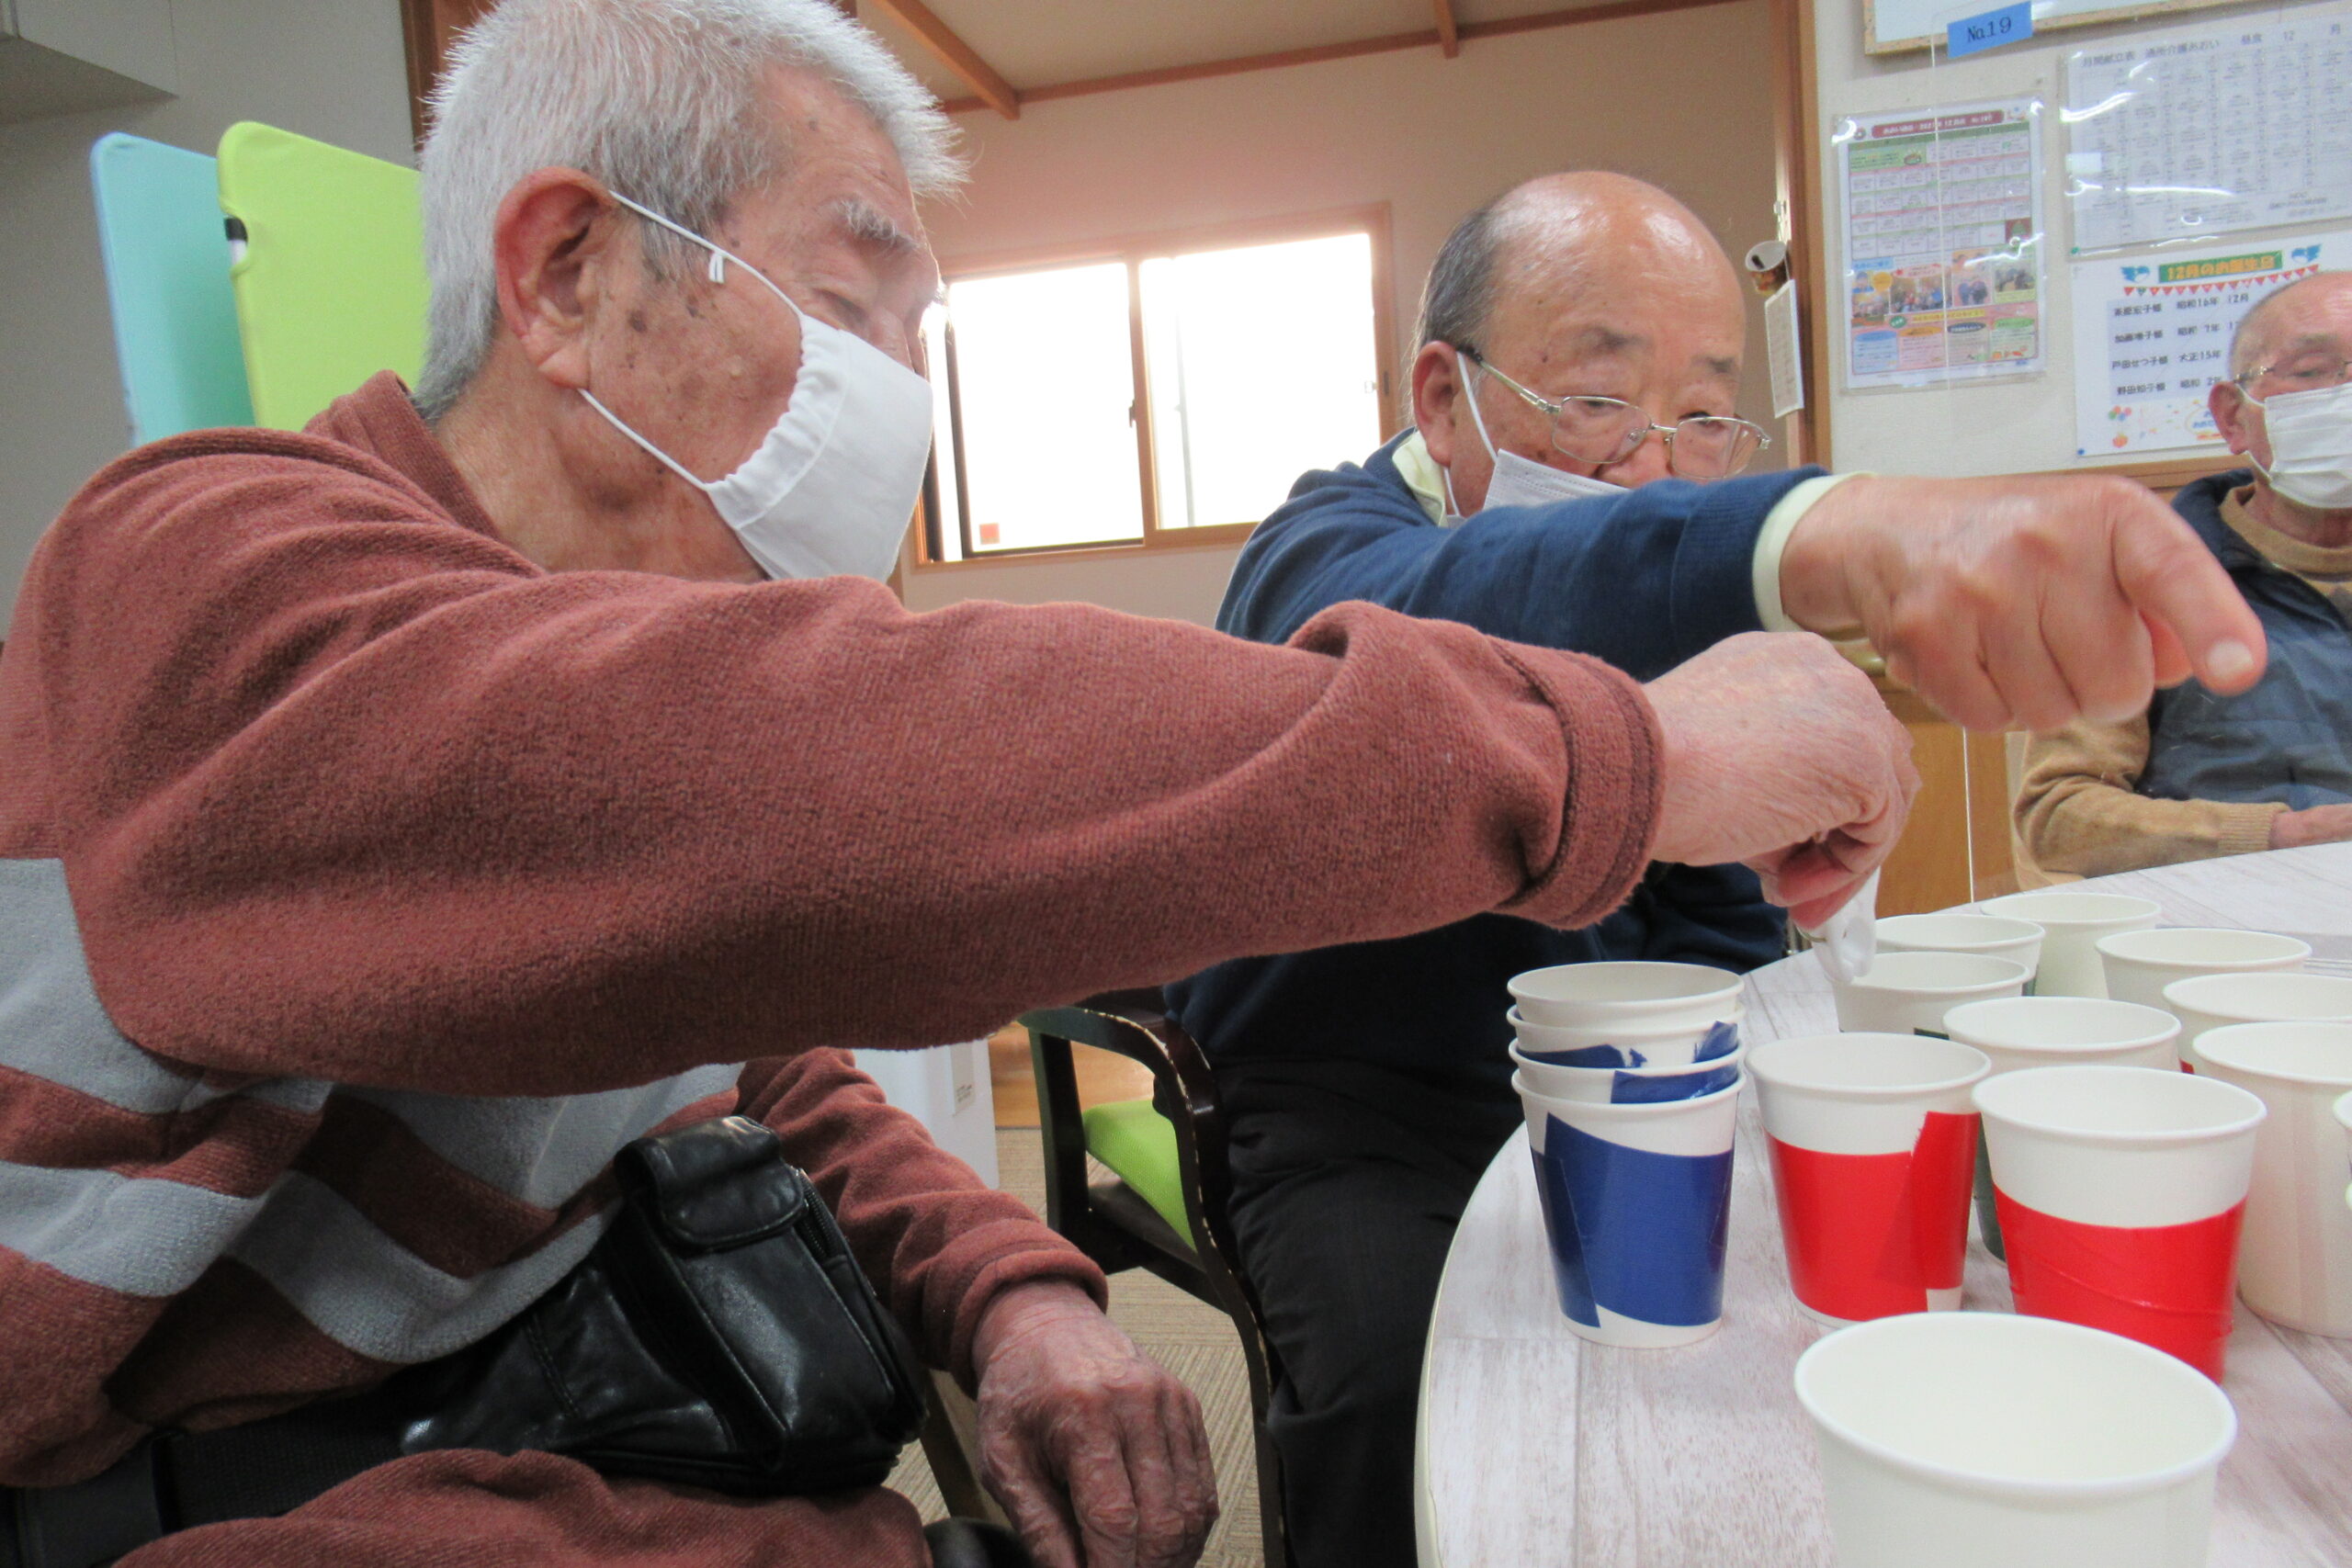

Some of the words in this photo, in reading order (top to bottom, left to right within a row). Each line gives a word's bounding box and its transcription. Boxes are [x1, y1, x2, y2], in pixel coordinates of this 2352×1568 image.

[2177, 296, 2219, 310] 昭和16年
[2228, 293, 2249, 304] 12月
[2179, 350, 2222, 363] 大正15年
[2180, 378, 2200, 389] 昭和
